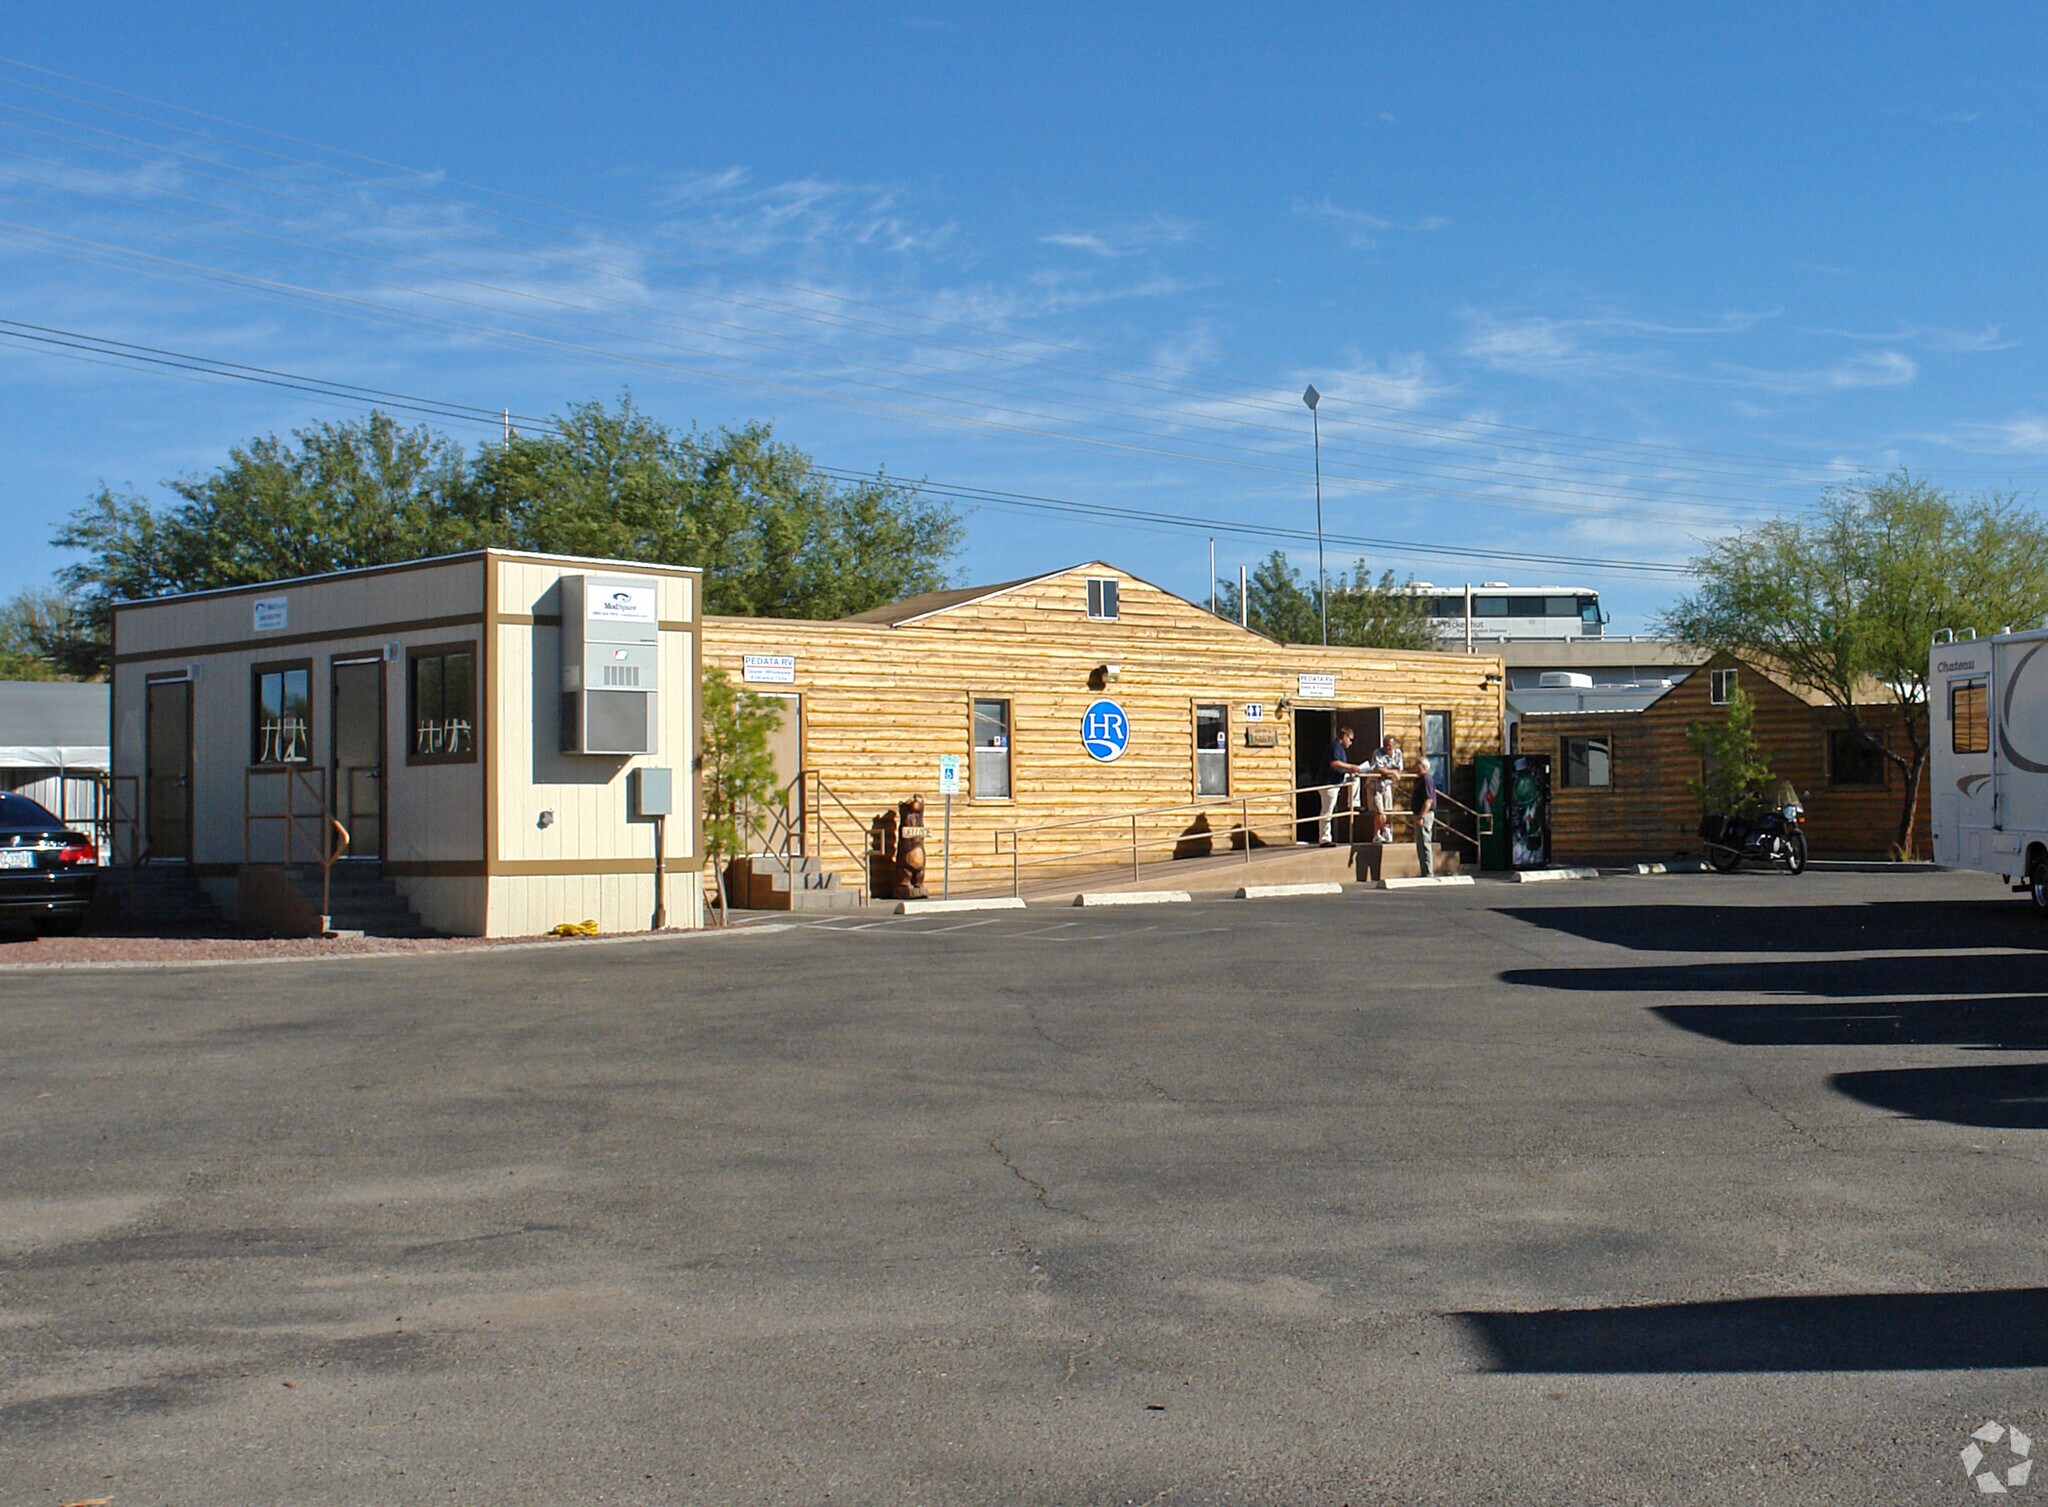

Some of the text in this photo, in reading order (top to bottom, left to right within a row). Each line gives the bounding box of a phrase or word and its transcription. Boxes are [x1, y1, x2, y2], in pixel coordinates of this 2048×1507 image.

[604, 602, 636, 612] ModSpace
[745, 656, 793, 666] PEDATA RV
[1937, 660, 1975, 673] Chateau
[1089, 713, 1124, 739] HR
